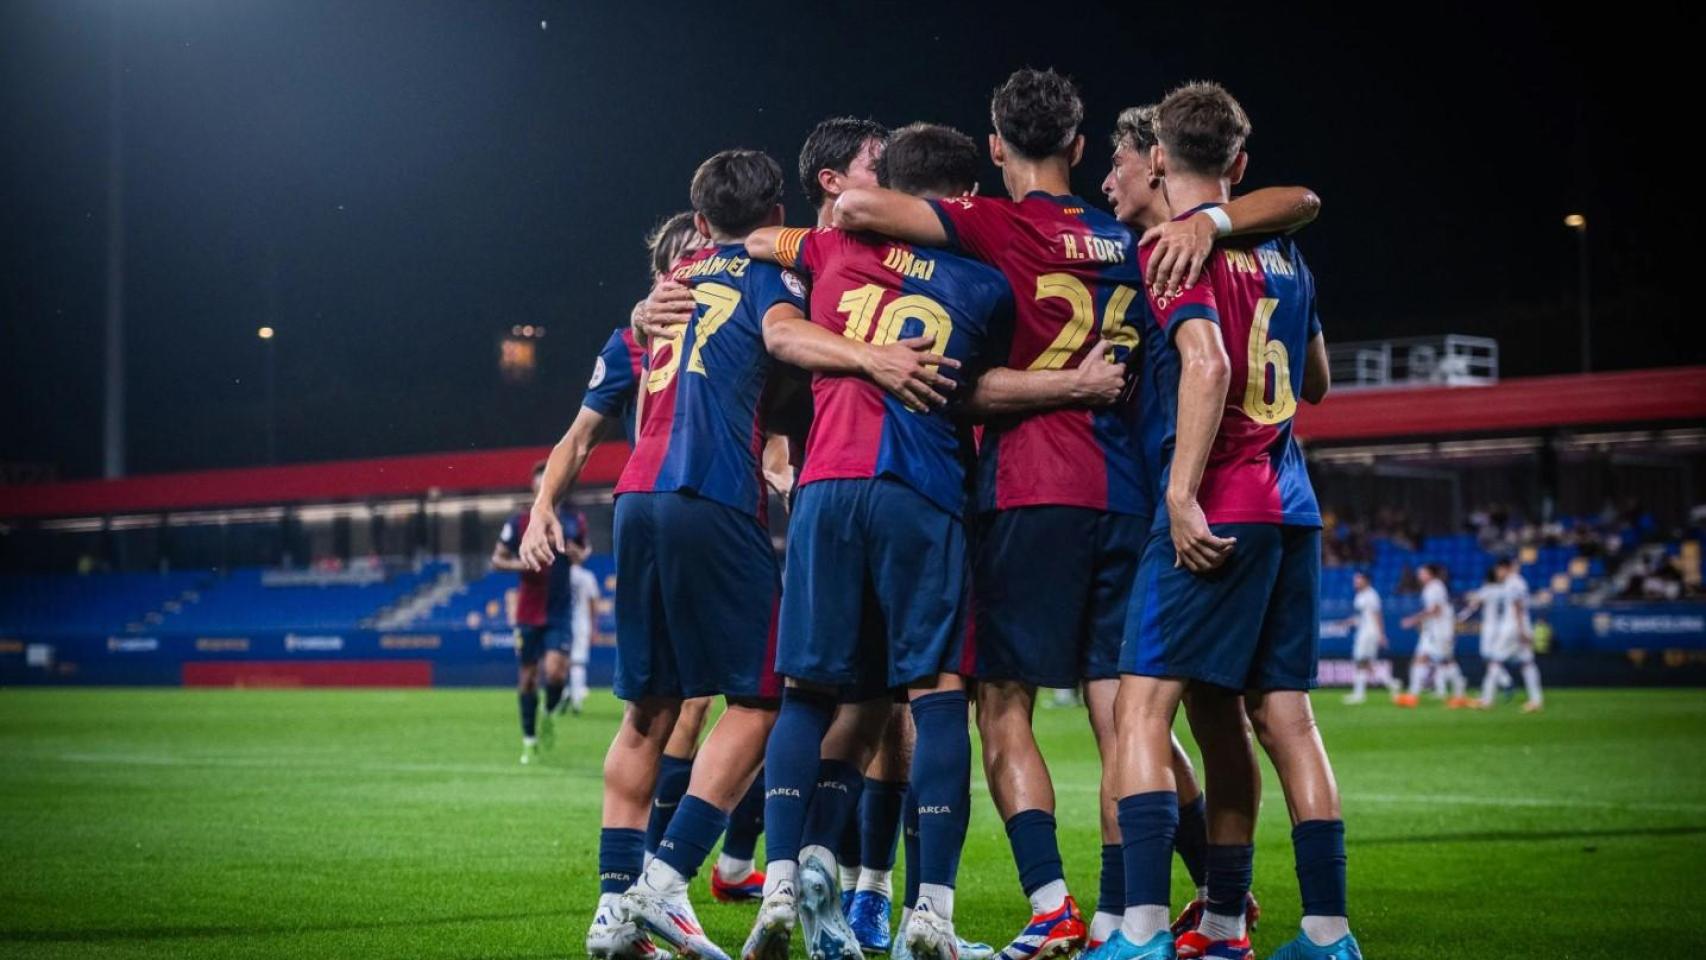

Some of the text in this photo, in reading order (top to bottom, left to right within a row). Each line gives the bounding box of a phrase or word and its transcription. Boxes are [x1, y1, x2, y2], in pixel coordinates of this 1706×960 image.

[882, 247, 935, 281] UNAI
[1063, 233, 1125, 264] H. FORT
[1027, 272, 1140, 369] 26
[1243, 297, 1297, 424] 6
